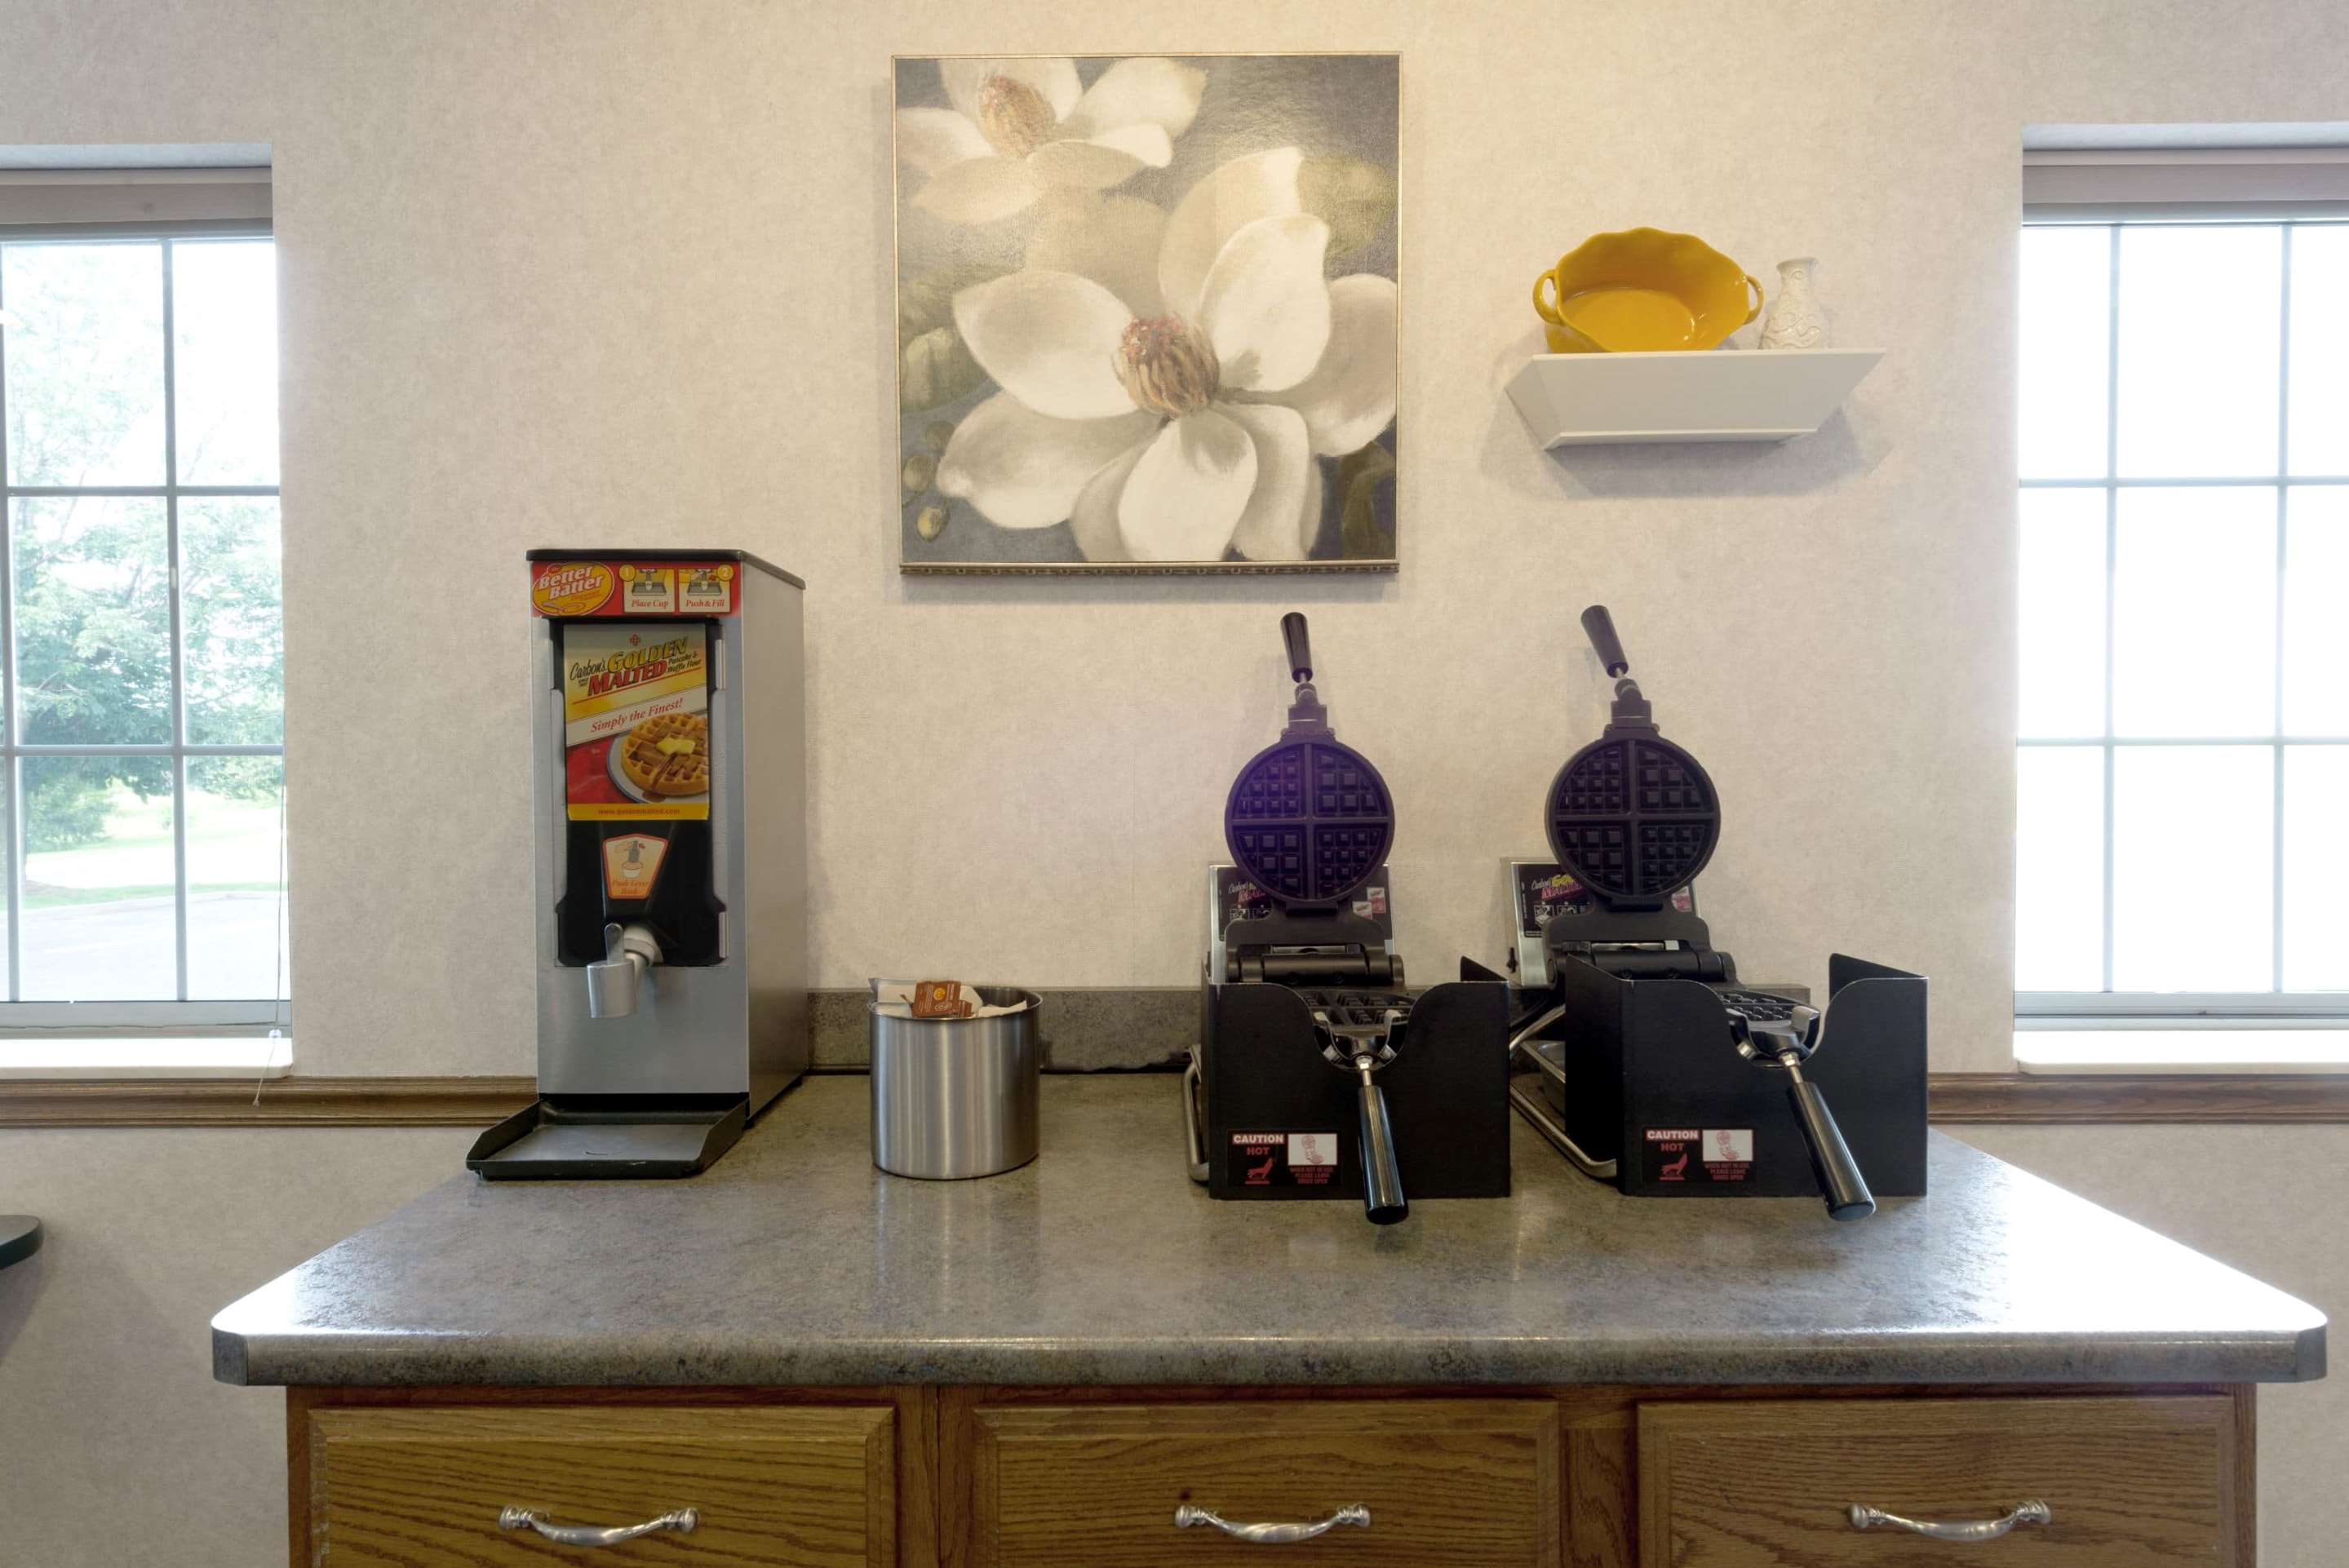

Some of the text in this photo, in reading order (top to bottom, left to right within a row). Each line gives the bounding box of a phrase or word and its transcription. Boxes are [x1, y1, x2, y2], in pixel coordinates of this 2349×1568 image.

[538, 566, 593, 589] Better
[549, 576, 603, 600] Batter
[632, 600, 669, 609] Place Cup
[685, 600, 703, 608] Push
[711, 600, 725, 608] Fill
[607, 636, 689, 673] GOLDEN
[587, 660, 667, 697] MALTED
[591, 698, 684, 733] Simply the Finest!
[1233, 1134, 1284, 1144] CAUTION
[1647, 1130, 1699, 1140] CAUTION
[1247, 1147, 1270, 1156] HOT
[1660, 1143, 1685, 1152] HOT
